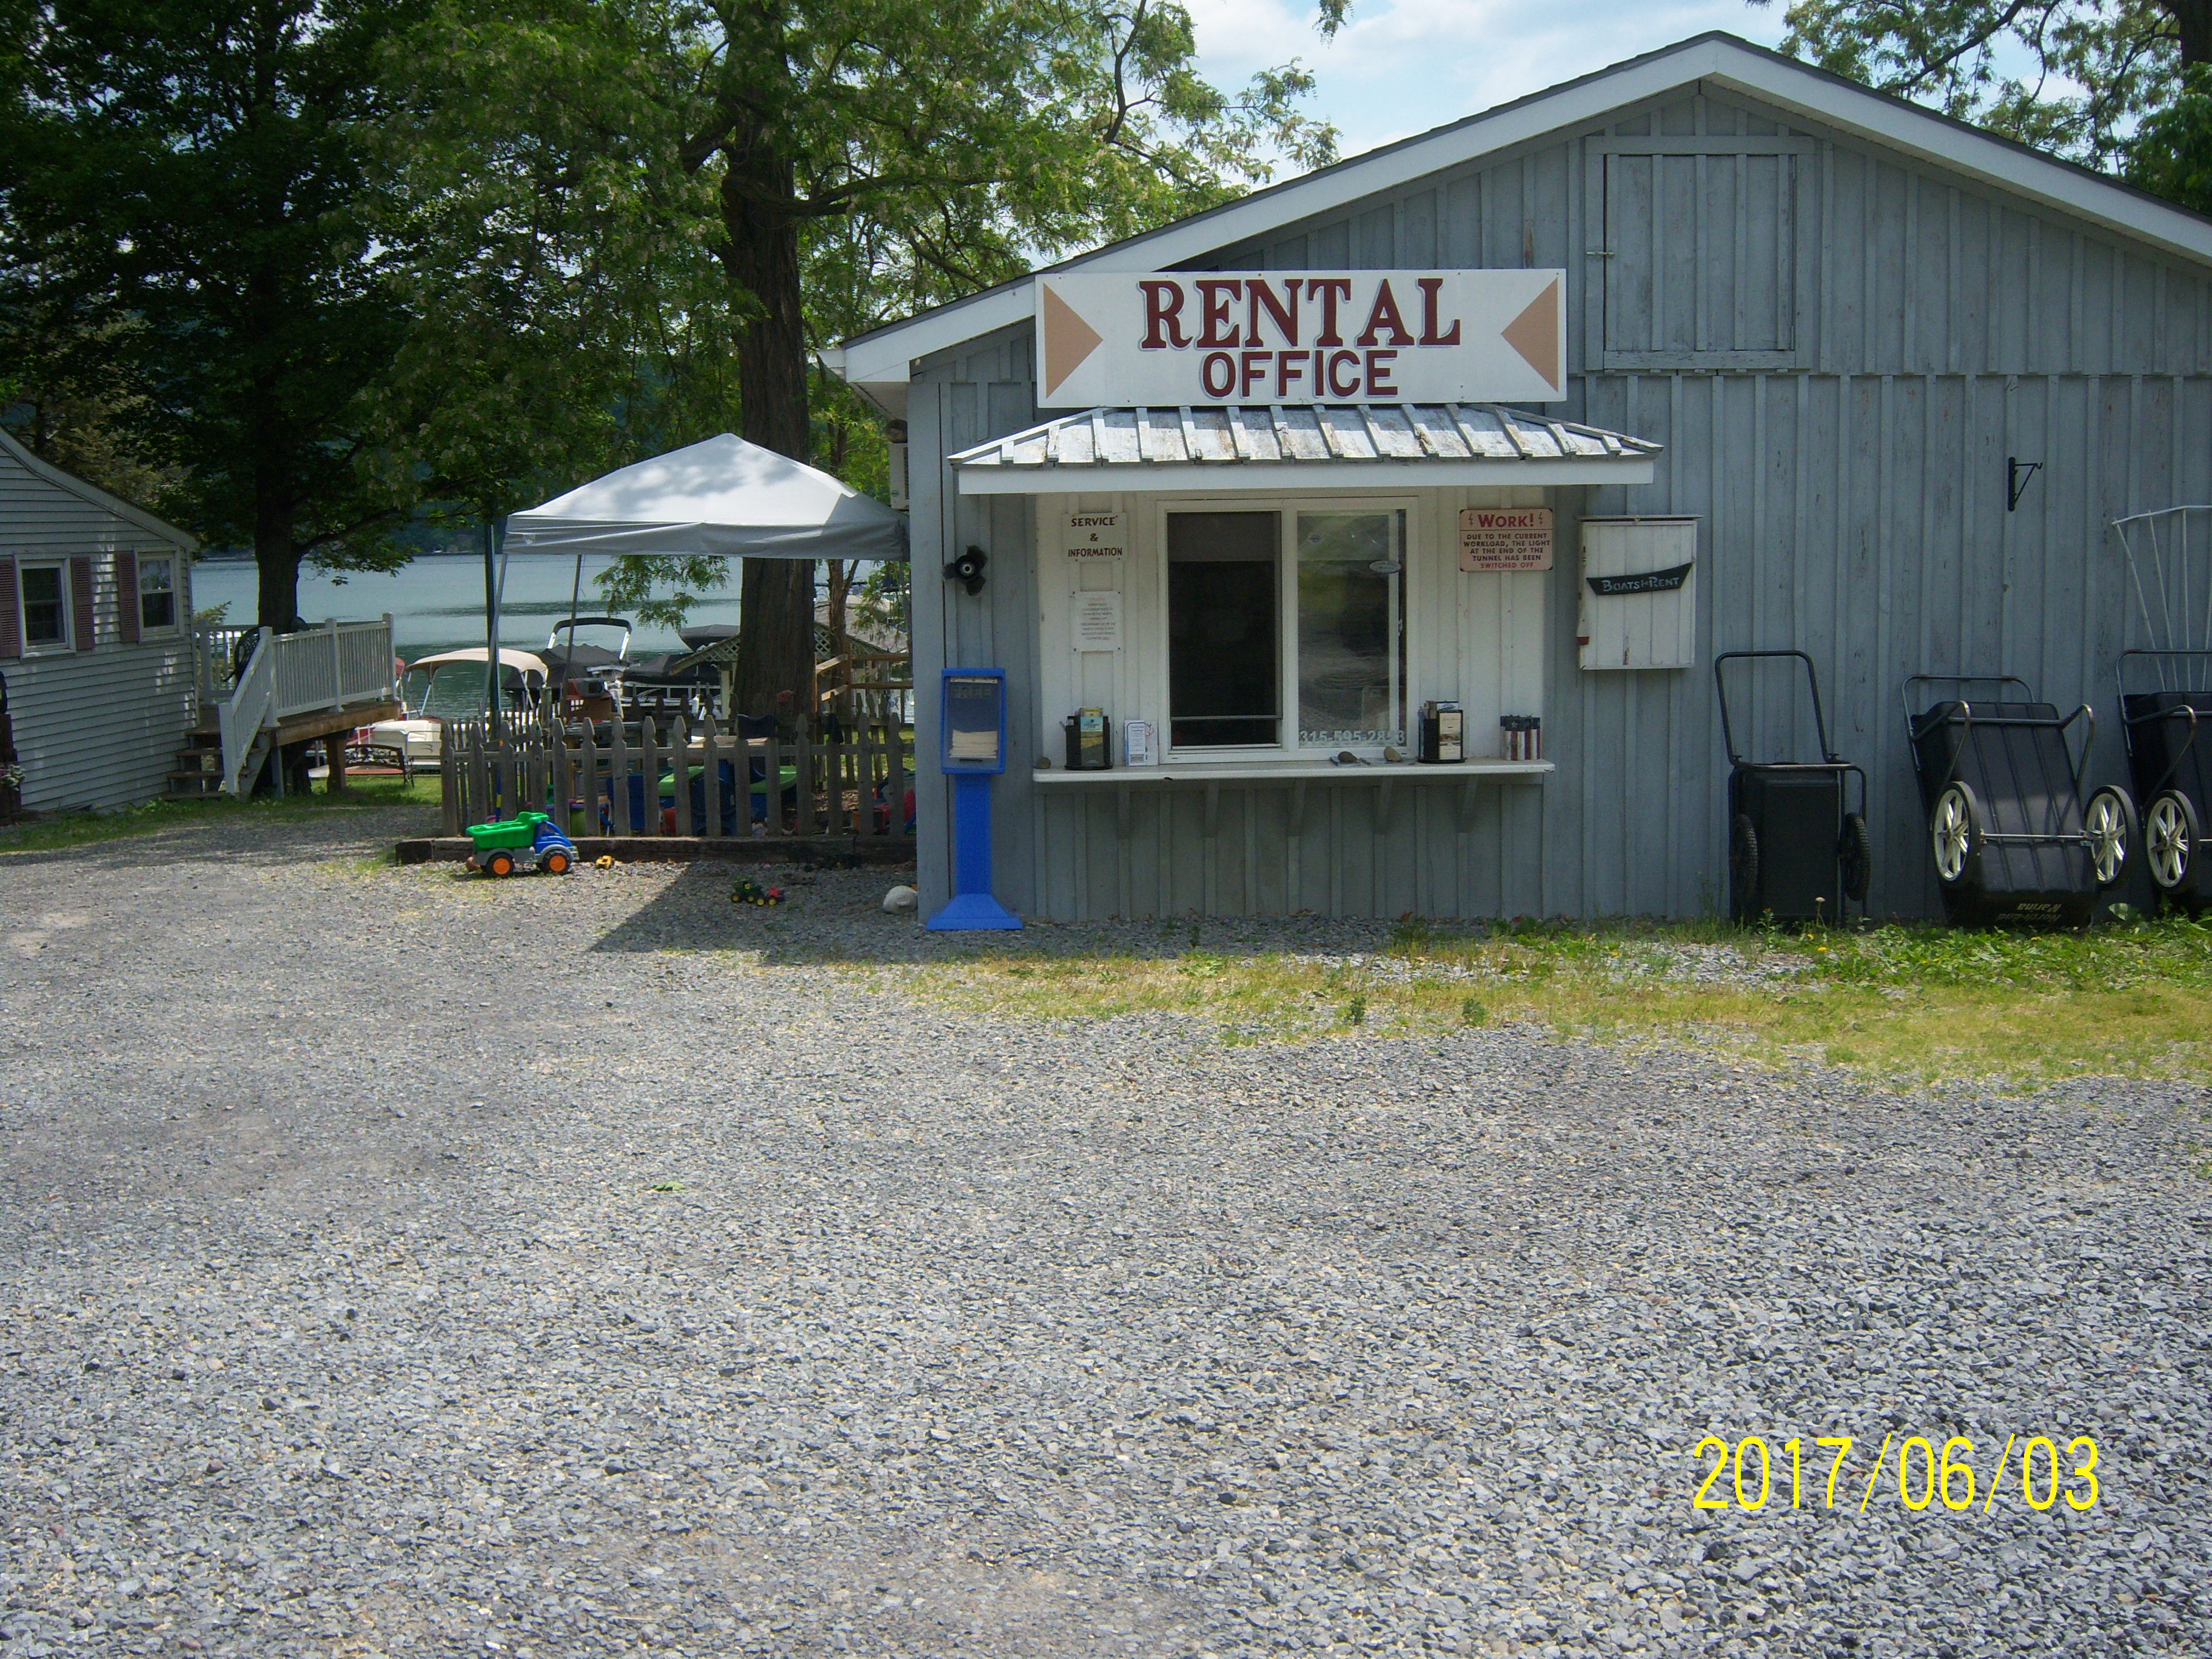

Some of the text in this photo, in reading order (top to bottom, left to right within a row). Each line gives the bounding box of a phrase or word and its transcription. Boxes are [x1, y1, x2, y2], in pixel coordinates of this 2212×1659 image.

[1136, 278, 1461, 349] RENTAL
[1201, 350, 1398, 398] OFFICE
[1071, 517, 1115, 527] SERVICE
[1477, 513, 1534, 528] WORK!
[1090, 533, 1098, 541] &
[1068, 547, 1122, 557] INFORMATION
